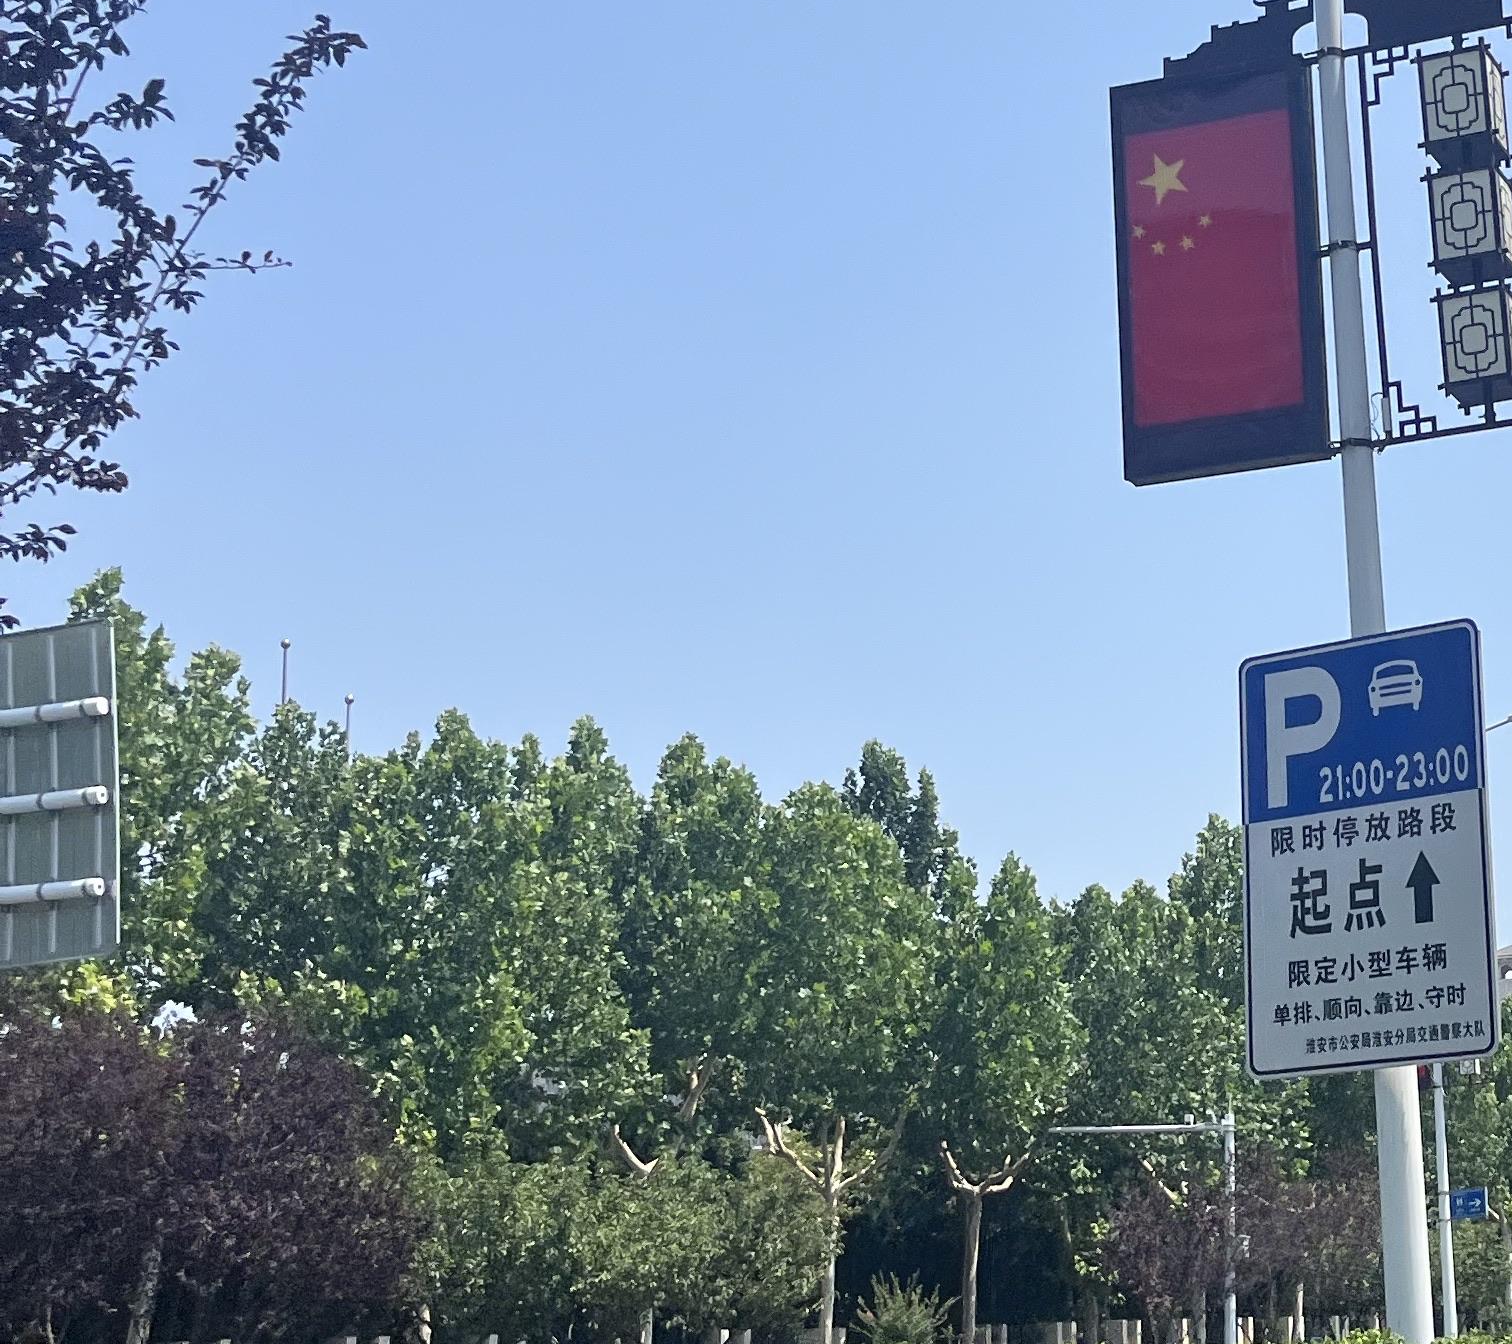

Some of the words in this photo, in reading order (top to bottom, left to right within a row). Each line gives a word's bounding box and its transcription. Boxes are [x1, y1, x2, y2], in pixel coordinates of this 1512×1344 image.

[1264, 666, 1341, 809] P
[1319, 744, 1469, 803] 21:00-23:00
[1271, 803, 1457, 857] 限时停放路段
[1289, 858, 1387, 939] 起点
[1288, 943, 1447, 989] 限定小型车辆
[1273, 982, 1467, 1026] 单排、顺向、靠边、守时
